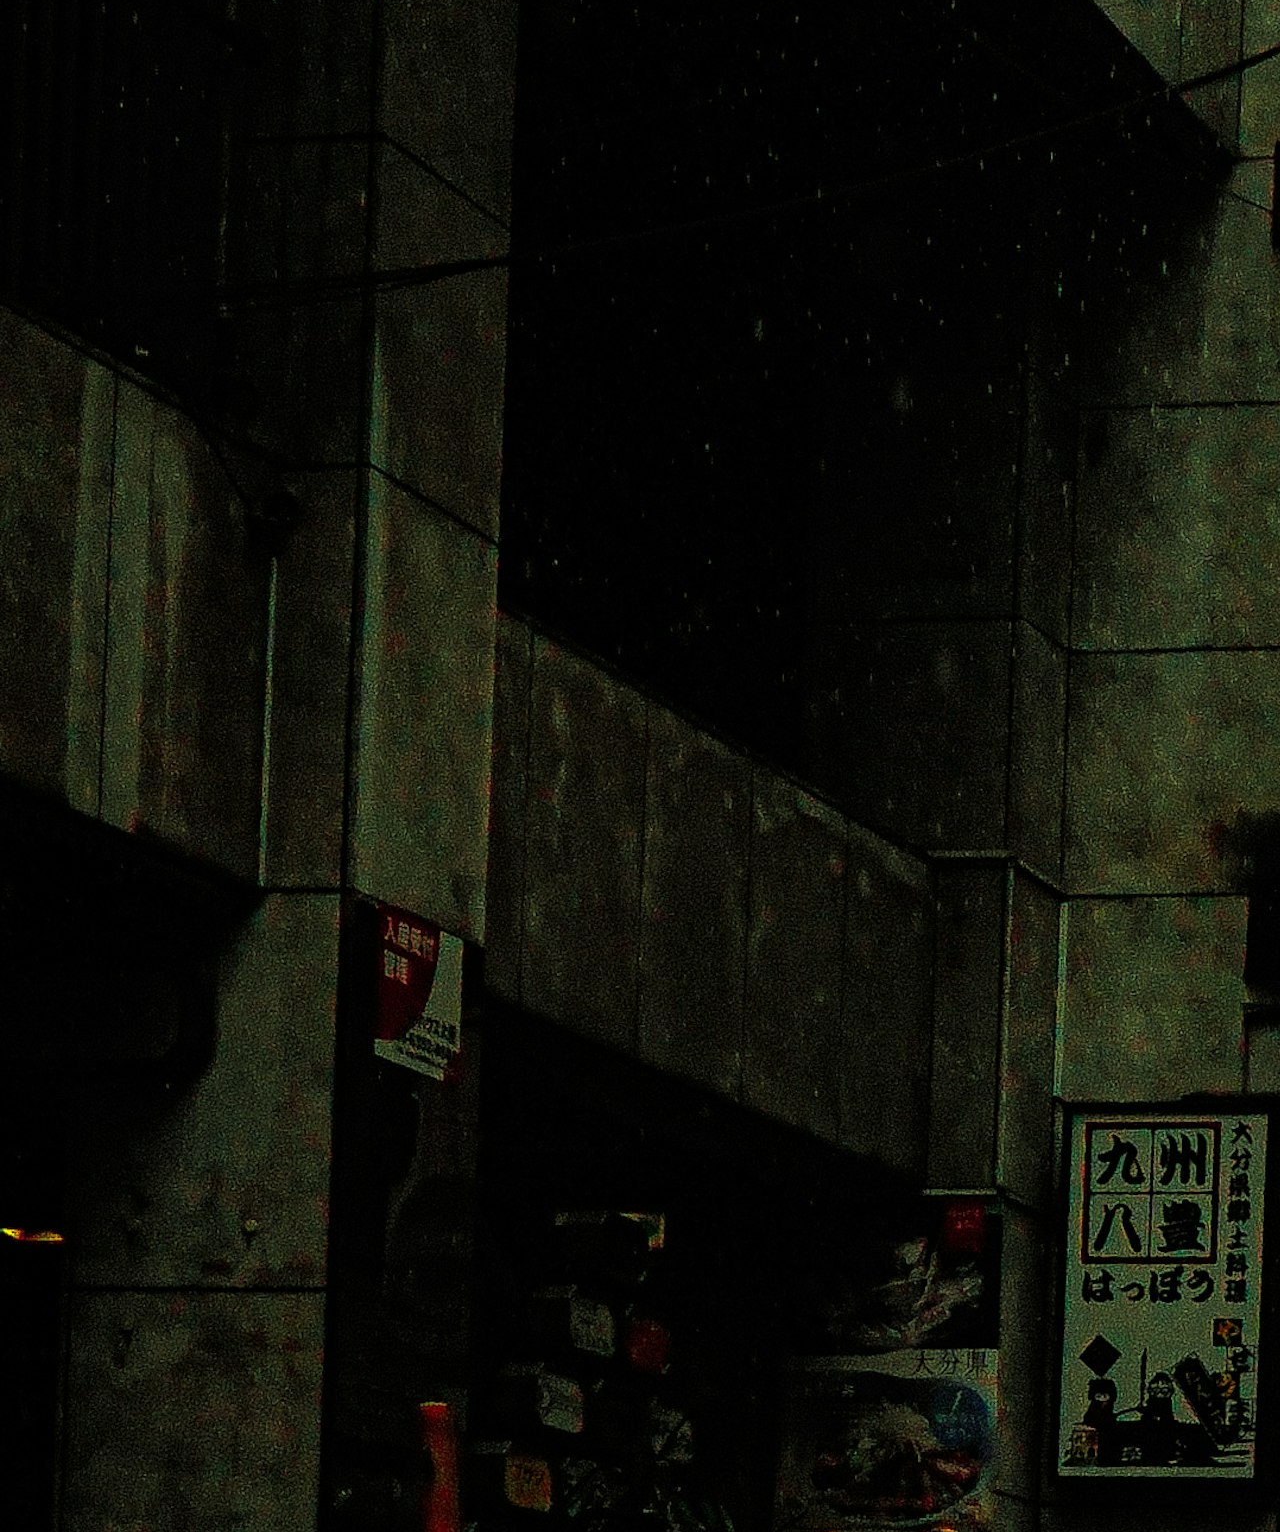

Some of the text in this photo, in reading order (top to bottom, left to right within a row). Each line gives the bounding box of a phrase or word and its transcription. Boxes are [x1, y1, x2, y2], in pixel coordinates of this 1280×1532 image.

[384, 949, 409, 986] 管理
[1096, 1133, 1207, 1187] 九州
[1094, 1199, 1207, 1253] 八豊
[1225, 1121, 1252, 1302] 大分県郷土料理
[1082, 1265, 1214, 1302] はっぽう
